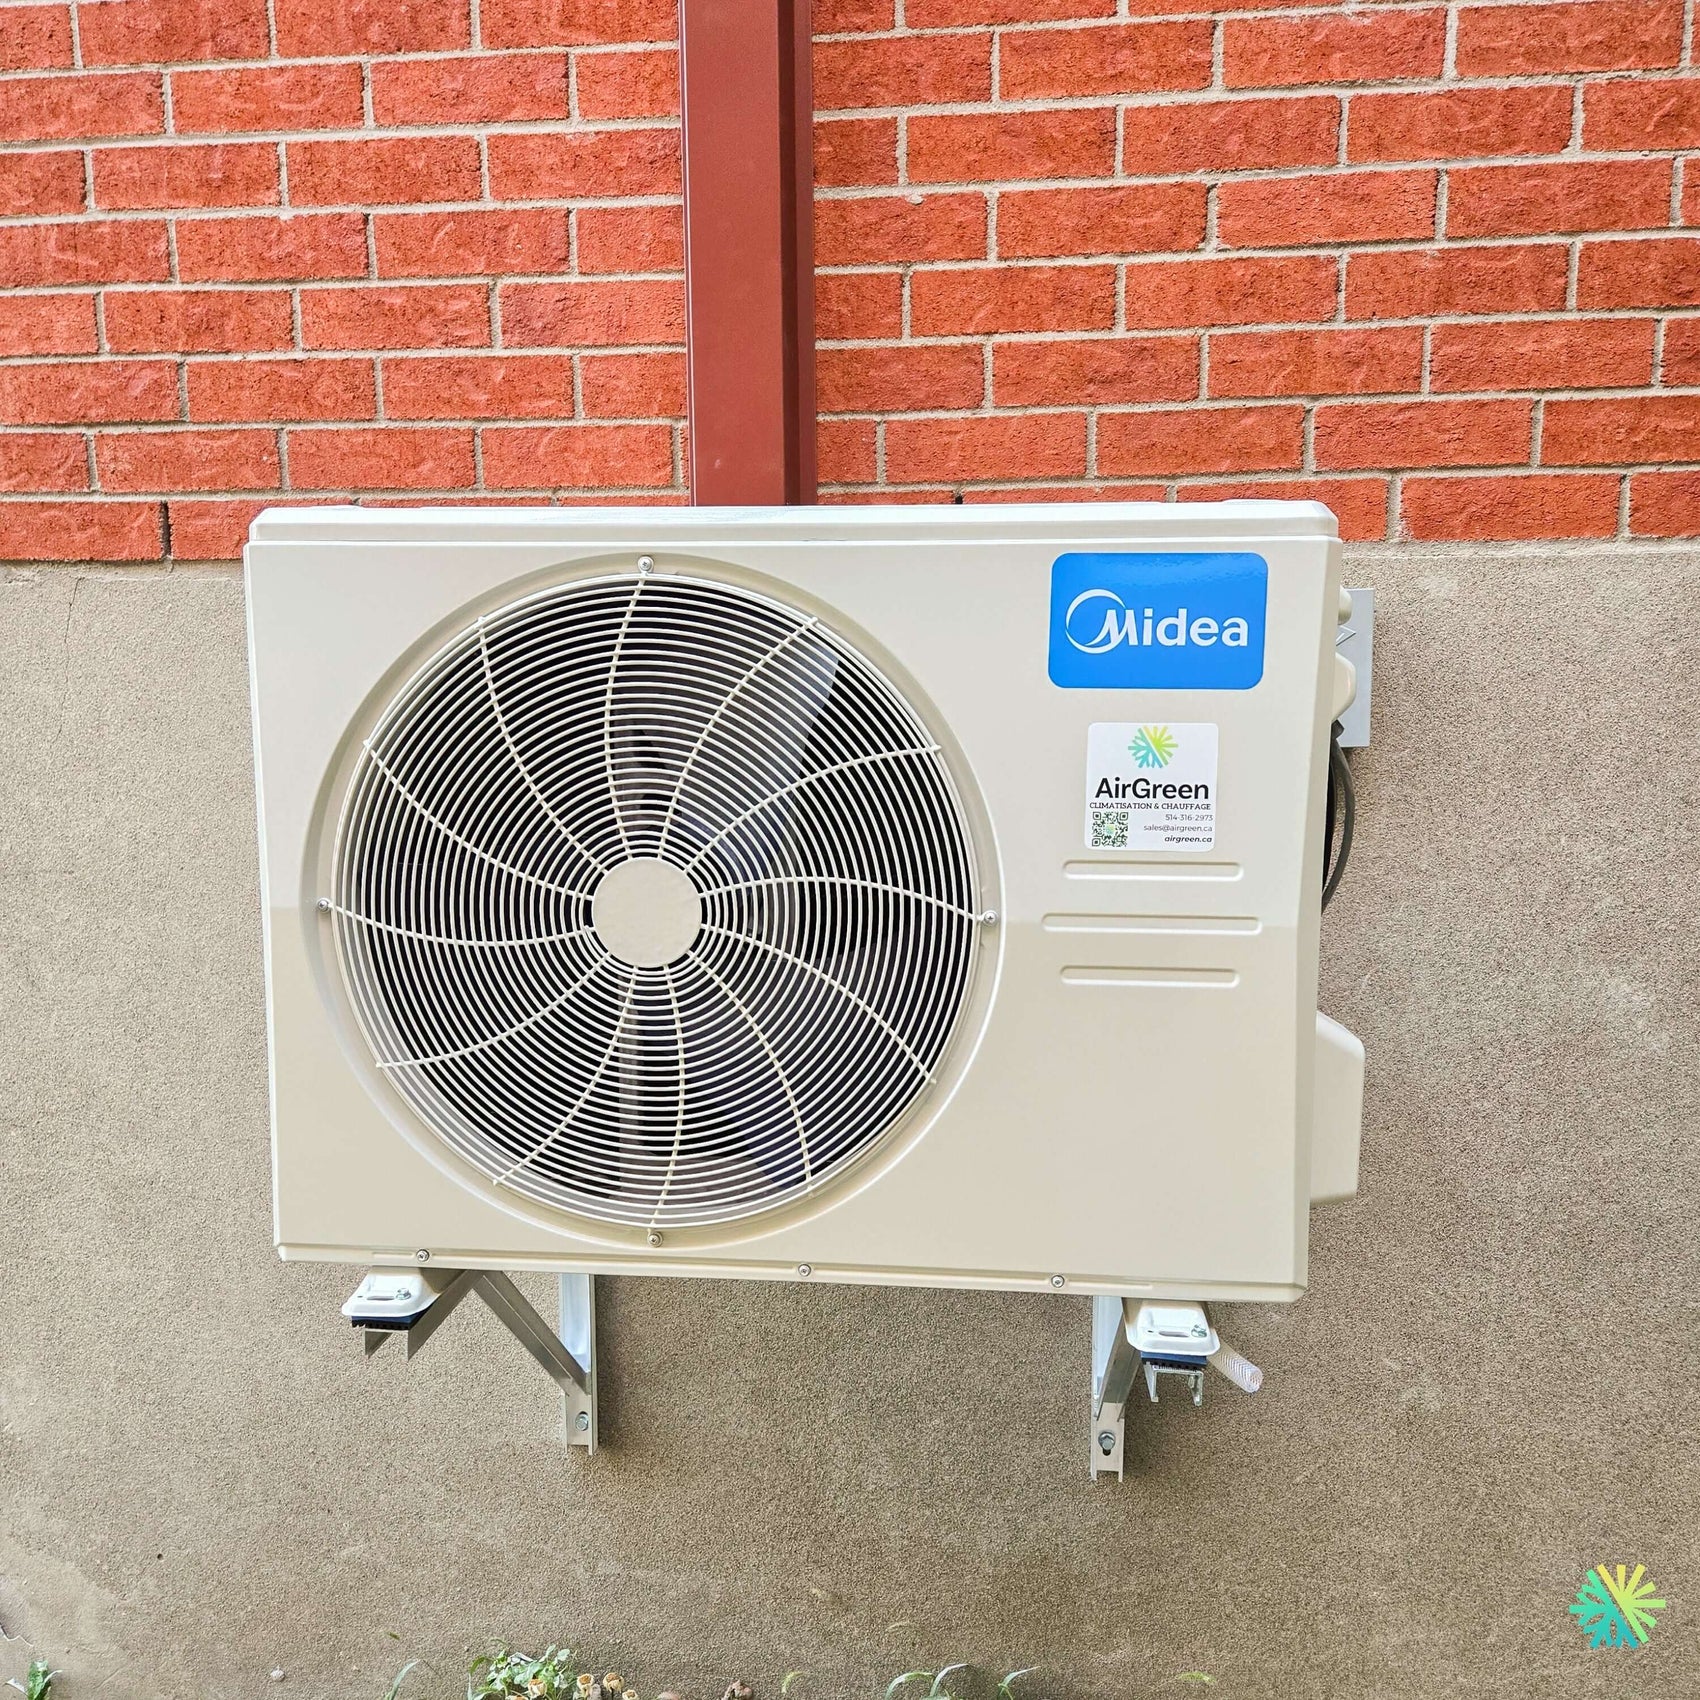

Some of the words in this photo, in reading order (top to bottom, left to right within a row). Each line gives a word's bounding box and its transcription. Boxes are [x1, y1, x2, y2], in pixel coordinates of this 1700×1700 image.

[1083, 607, 1249, 647] Midea
[1095, 777, 1209, 799] AirGreen
[1143, 824, 1213, 832] sales@airgreen.ca
